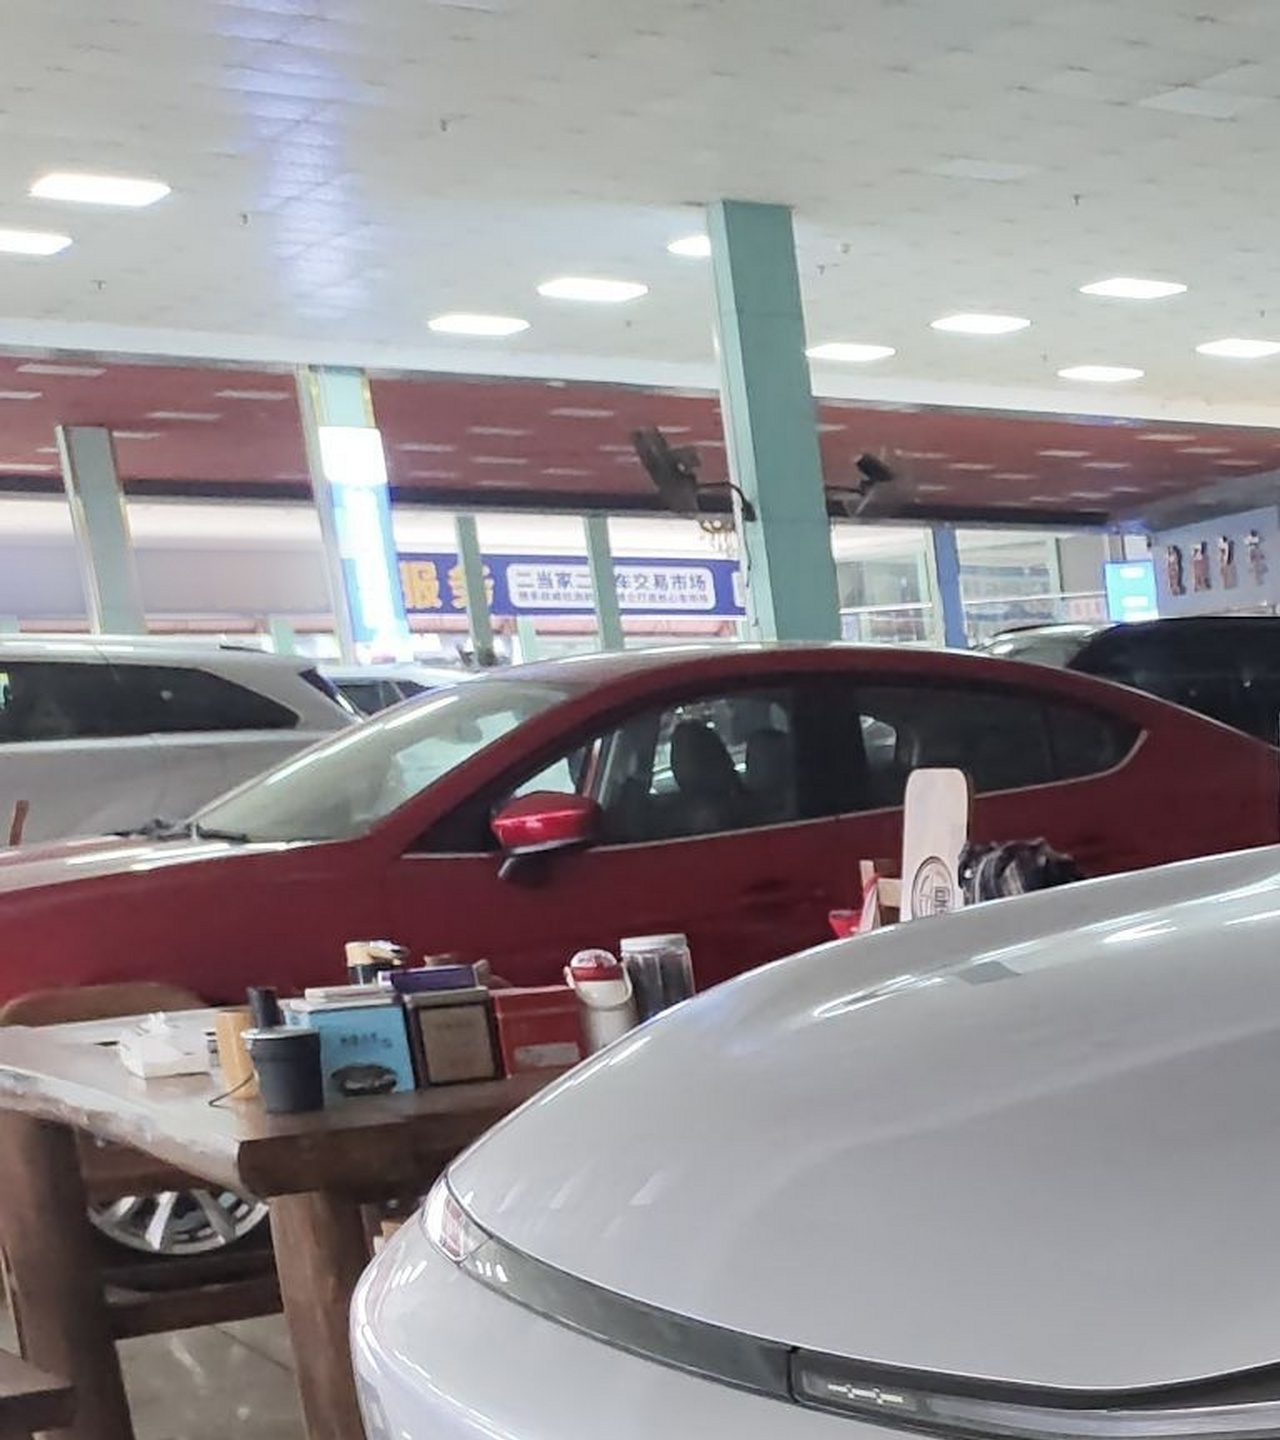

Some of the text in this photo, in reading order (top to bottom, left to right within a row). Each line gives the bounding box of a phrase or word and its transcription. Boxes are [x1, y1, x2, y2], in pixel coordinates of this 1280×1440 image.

[515, 570, 707, 591] 二当家二车交易市场
